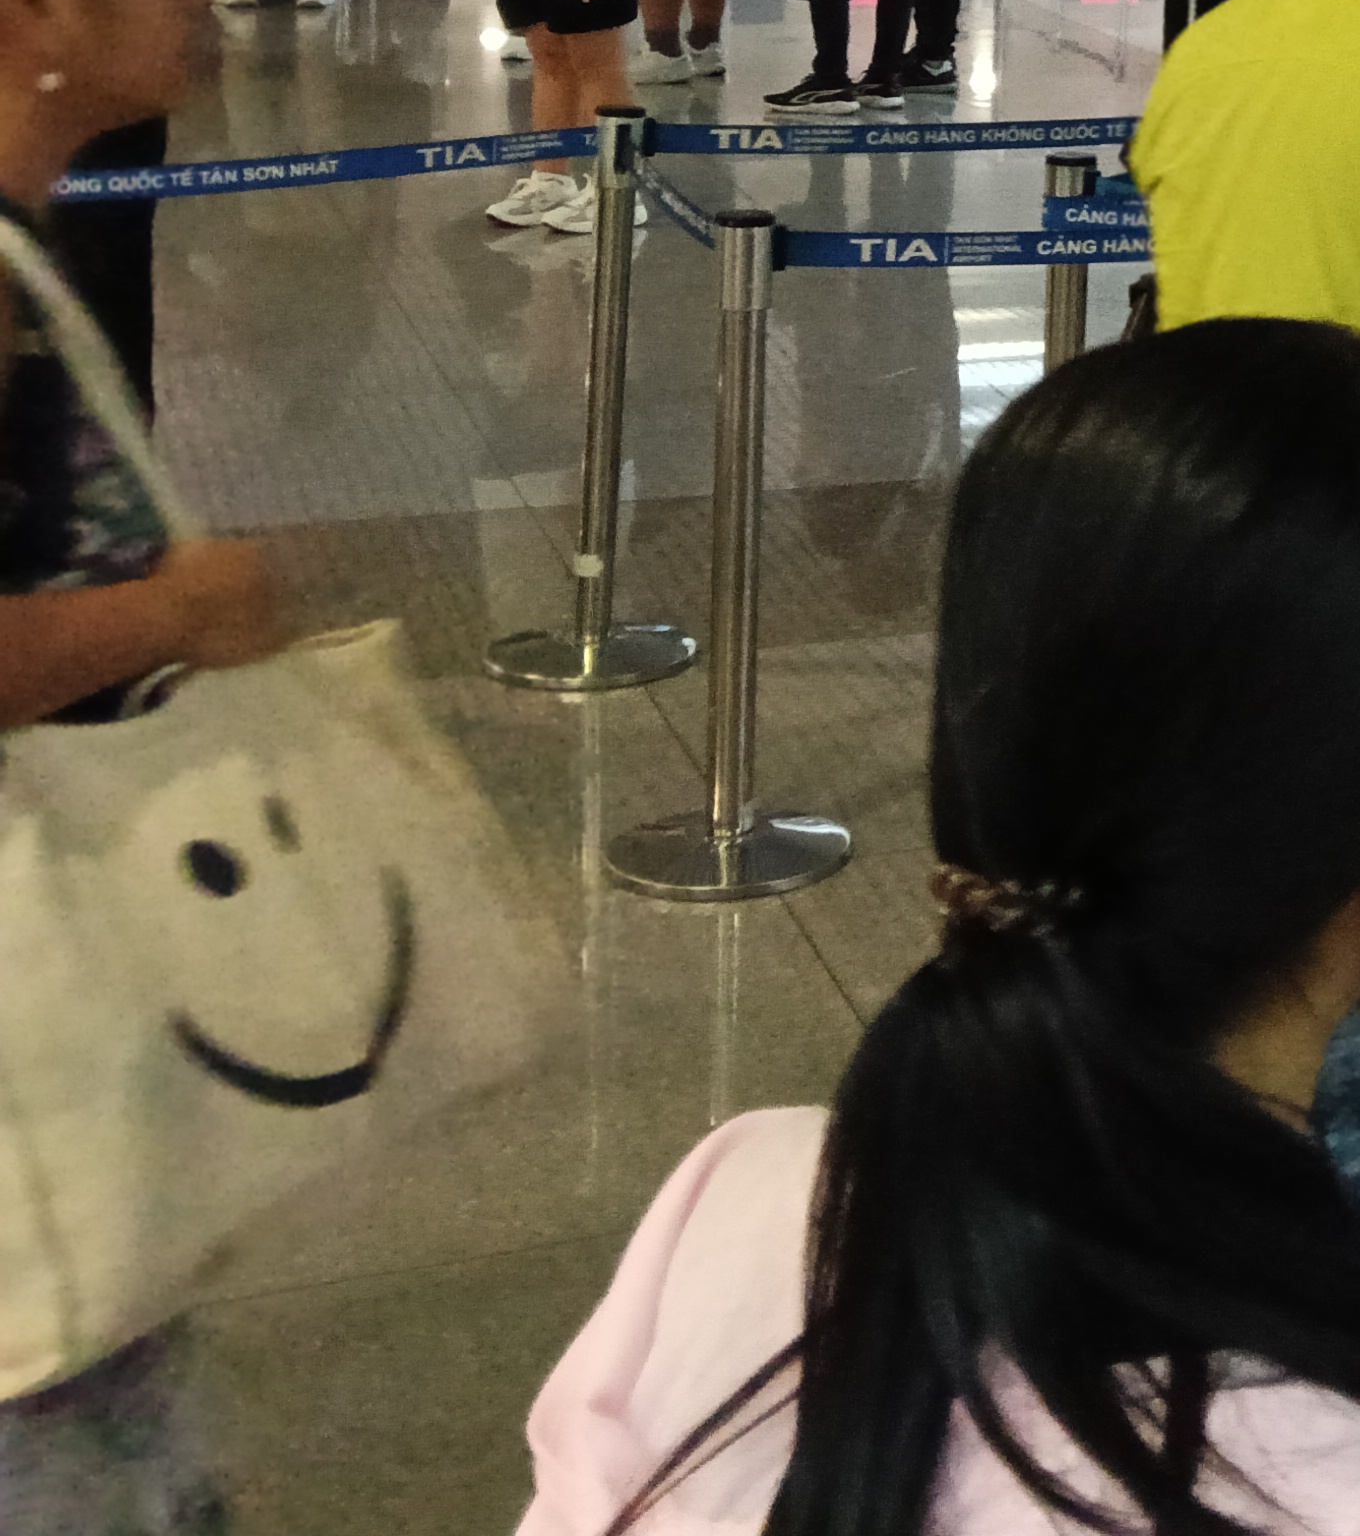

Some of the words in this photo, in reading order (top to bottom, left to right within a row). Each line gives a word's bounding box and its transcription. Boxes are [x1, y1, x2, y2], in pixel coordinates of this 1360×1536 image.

[710, 128, 784, 150] TIA
[980, 124, 1046, 143] KHÔNG
[50, 172, 102, 195] ÔNG
[108, 168, 165, 192] QUỐC
[171, 166, 194, 187] TẾ
[199, 166, 239, 185] TÂN
[243, 165, 284, 182] SƠN
[416, 142, 487, 168] TIA
[1065, 204, 1118, 225] CẢNG
[850, 238, 938, 263] TIA
[1037, 235, 1098, 255] CẢNG
